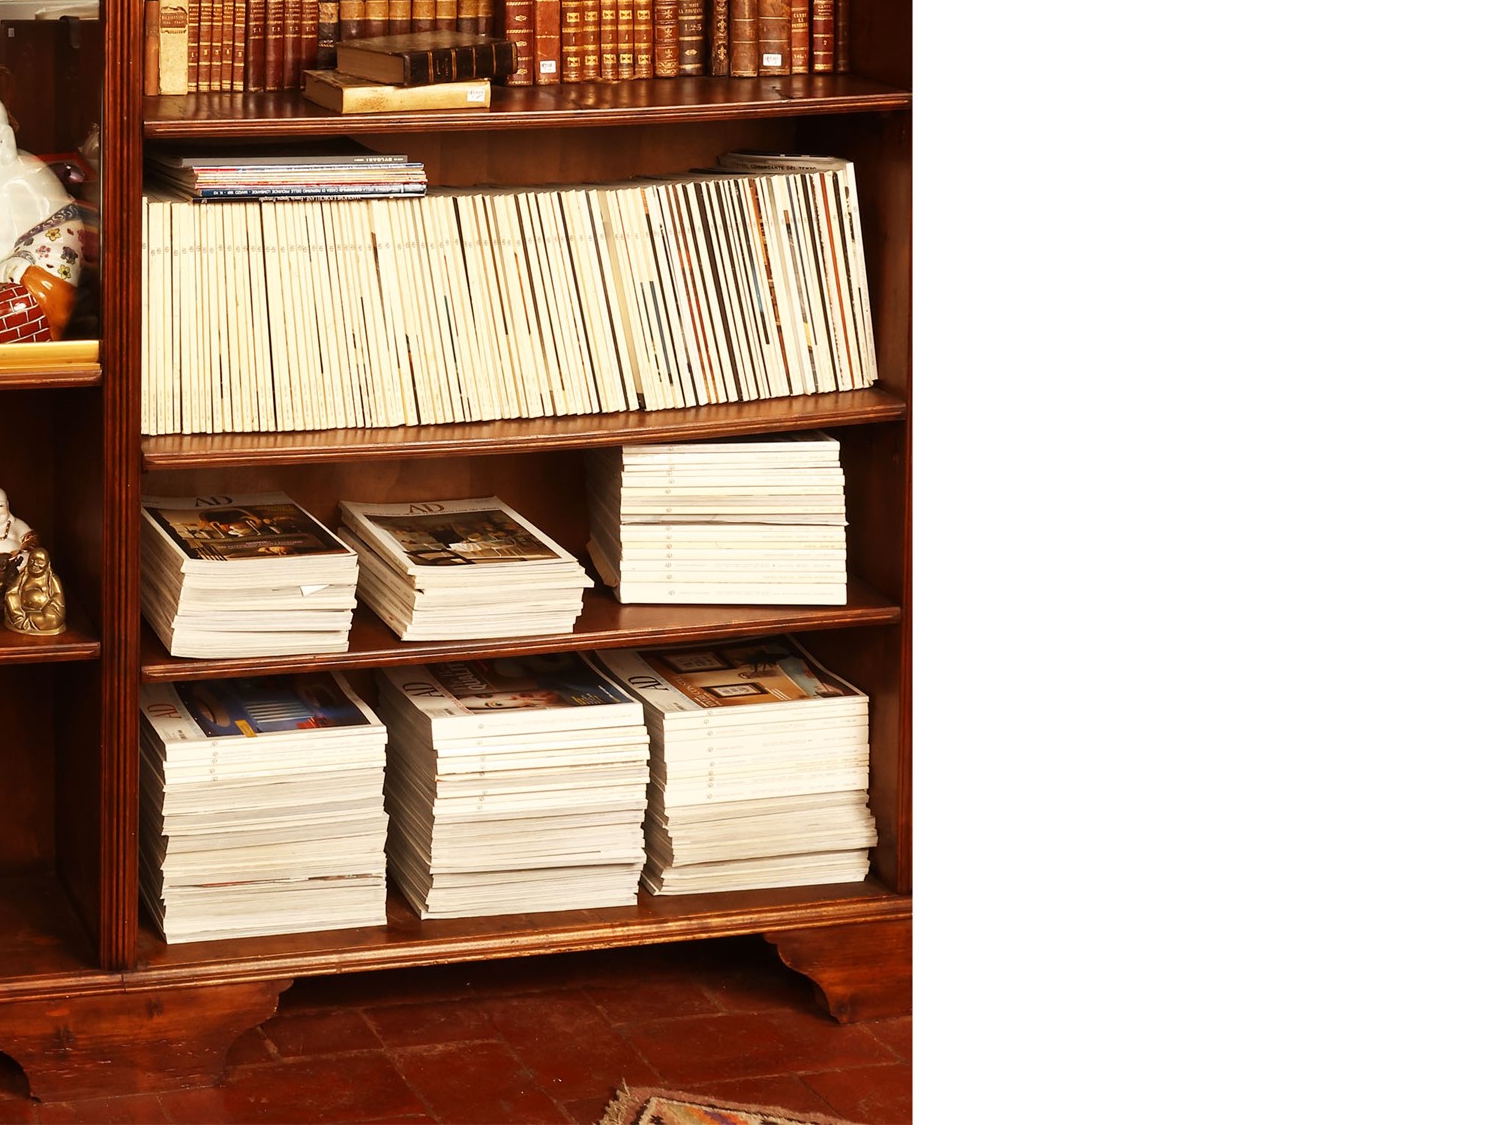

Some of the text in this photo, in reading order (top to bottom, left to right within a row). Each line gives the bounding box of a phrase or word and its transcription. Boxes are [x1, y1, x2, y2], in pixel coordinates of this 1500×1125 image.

[195, 496, 233, 507] AD
[410, 503, 445, 514] AD
[402, 682, 445, 698] AD
[628, 676, 670, 692] AD
[147, 703, 182, 719] AD
